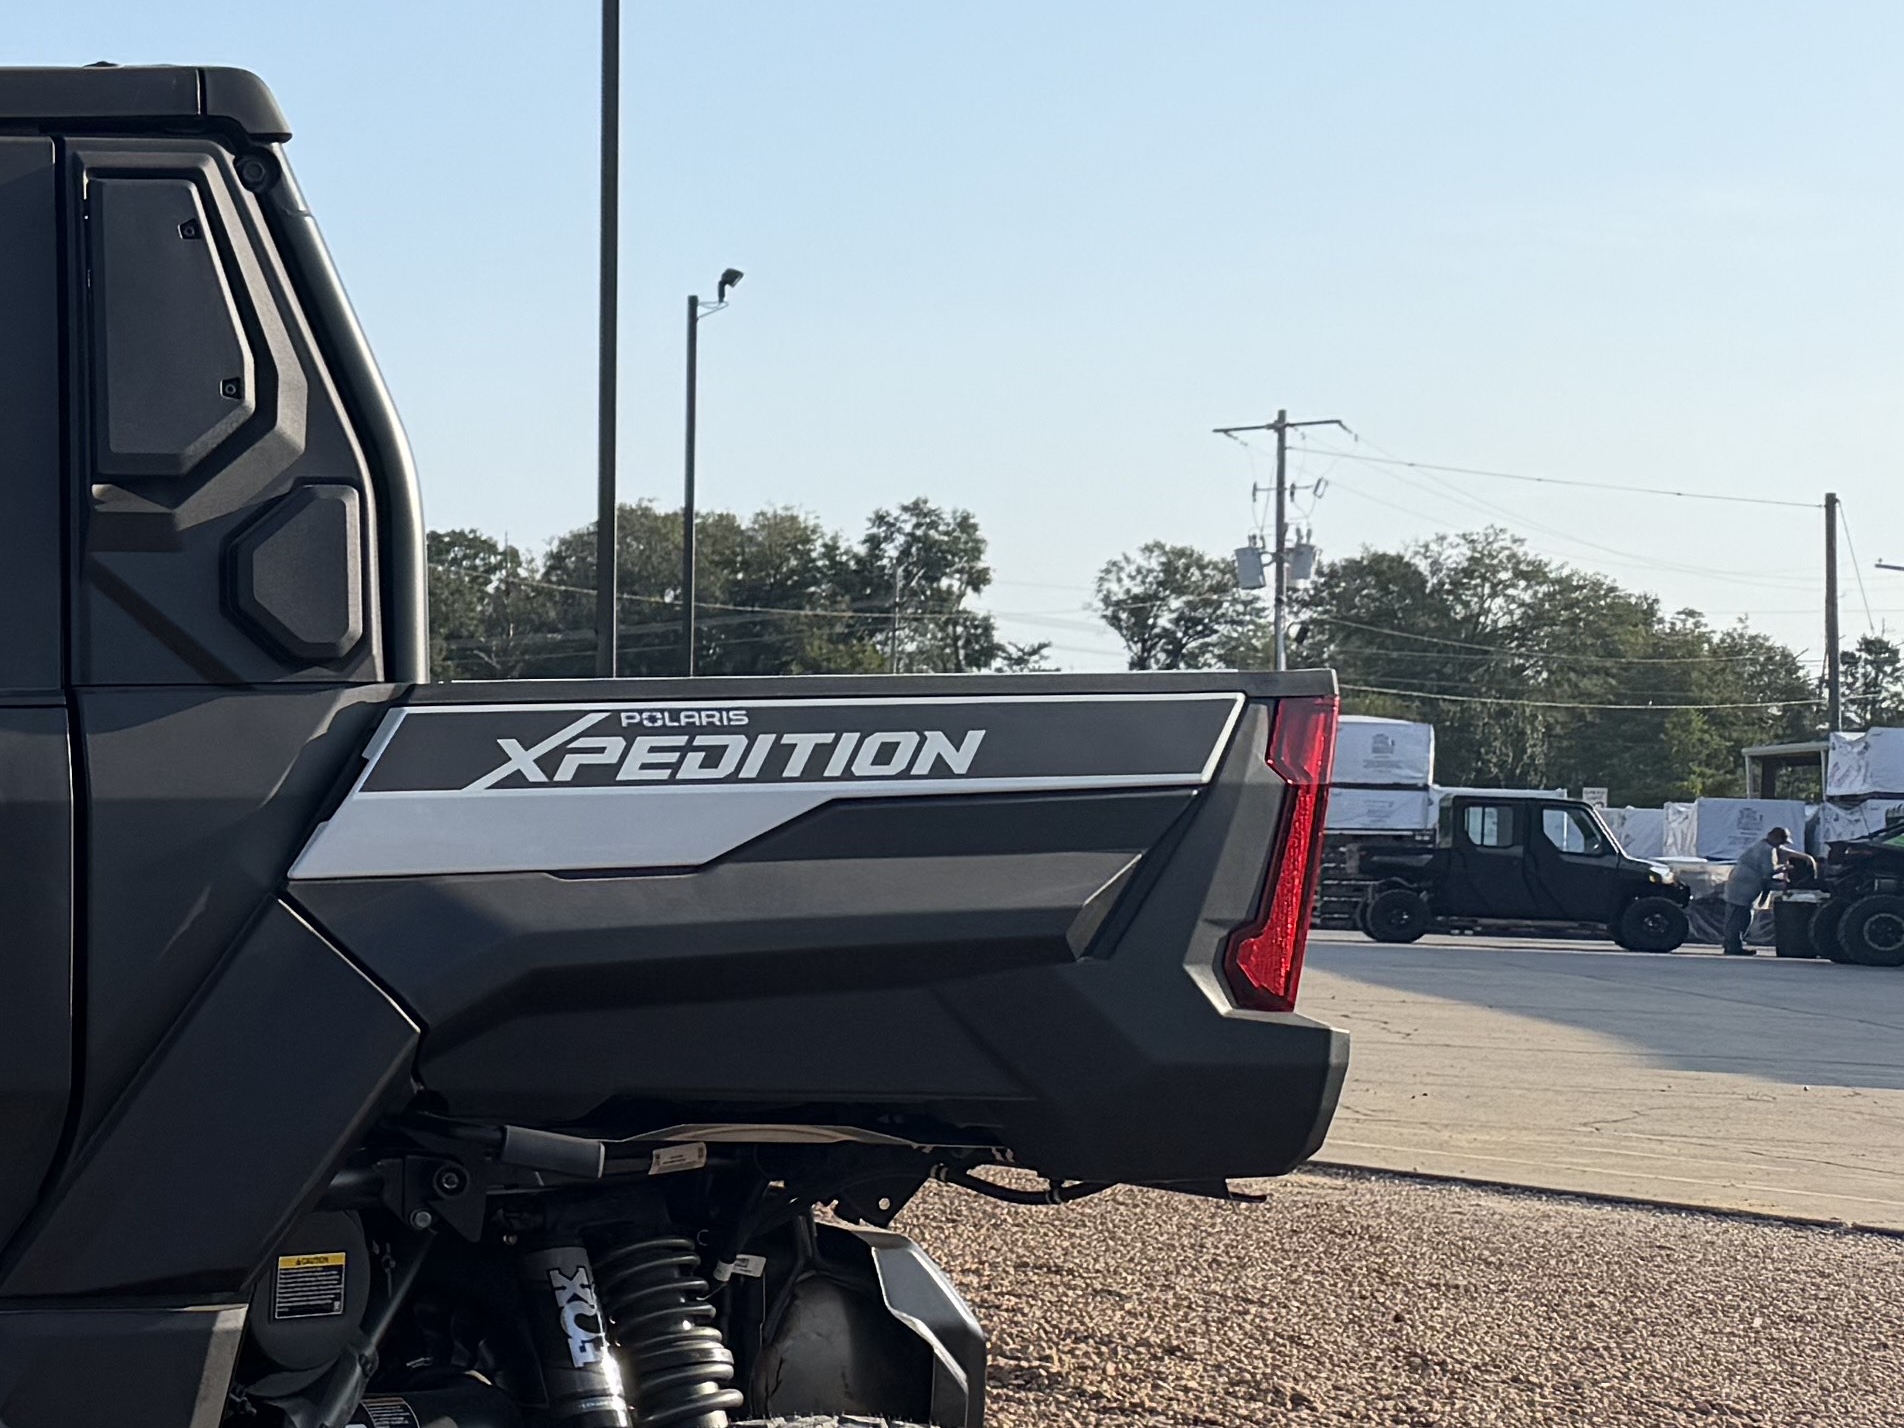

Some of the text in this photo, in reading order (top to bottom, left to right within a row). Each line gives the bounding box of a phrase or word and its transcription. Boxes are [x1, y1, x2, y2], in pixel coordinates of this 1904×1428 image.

[460, 712, 987, 791] XPEDITION
[620, 710, 750, 728] POLARIS
[547, 1265, 608, 1368] FOX
